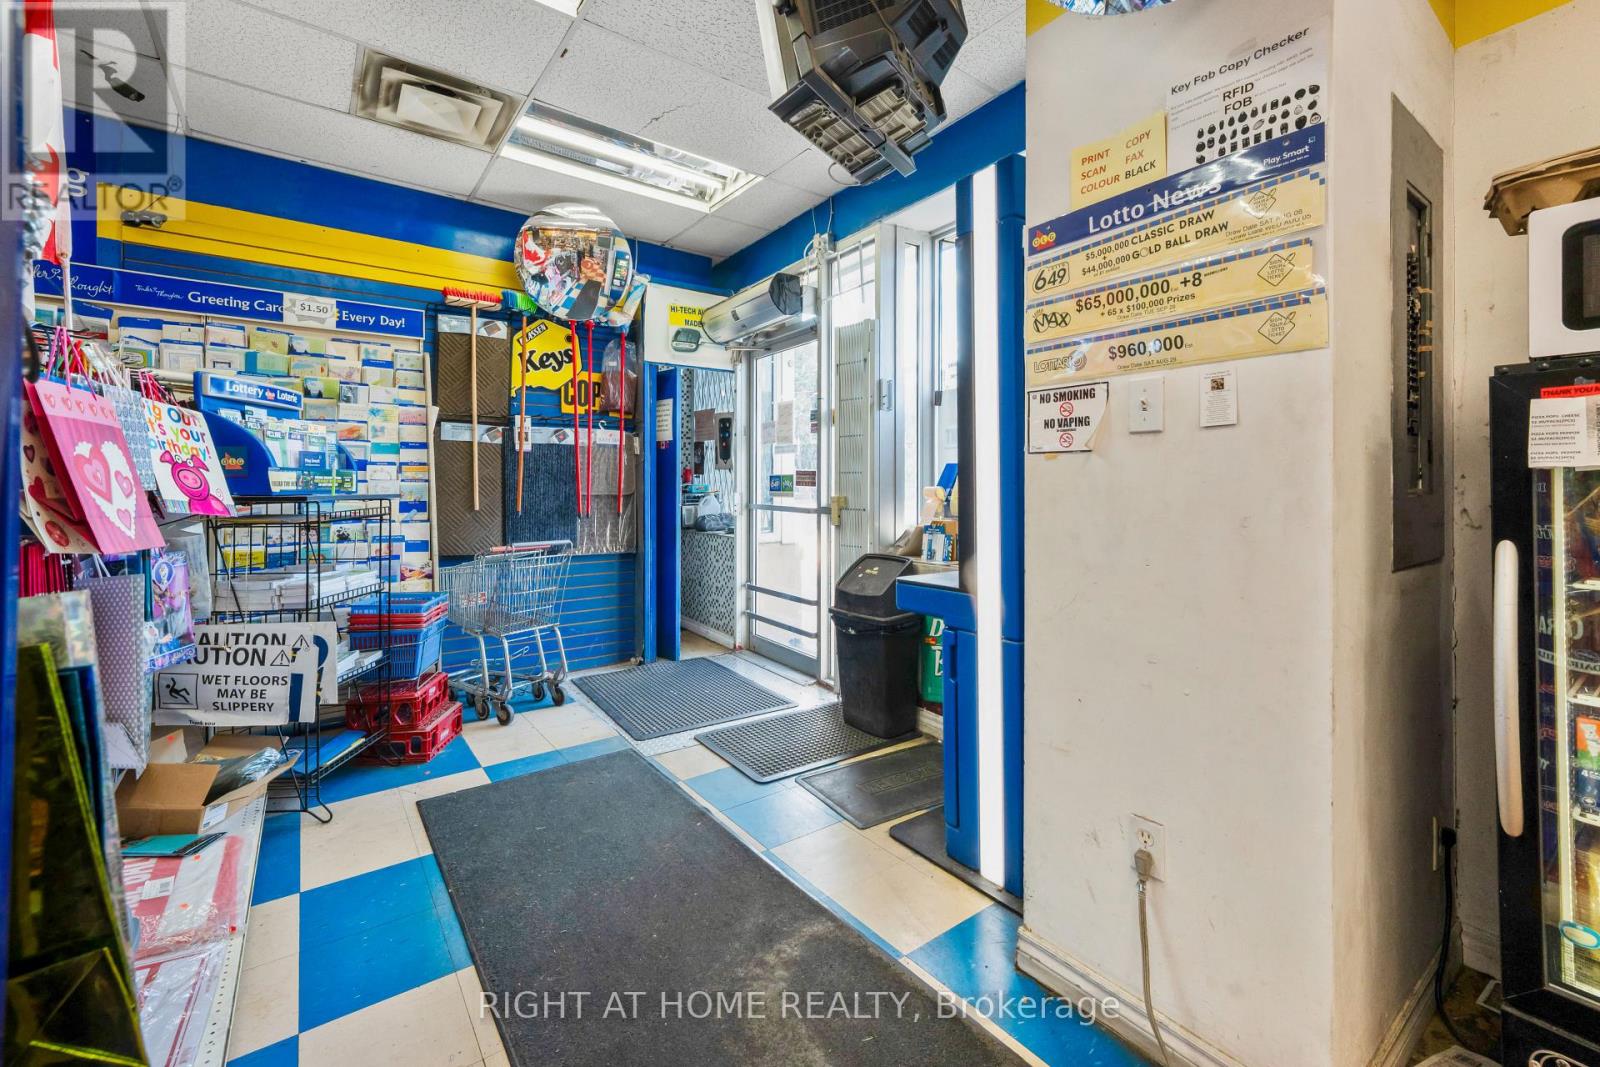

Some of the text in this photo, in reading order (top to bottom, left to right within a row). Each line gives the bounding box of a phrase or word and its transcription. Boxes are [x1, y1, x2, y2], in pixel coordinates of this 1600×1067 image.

[1171, 81, 1191, 96] Key
[1194, 70, 1215, 87] Fob
[1219, 54, 1251, 76] Copy
[1254, 27, 1310, 60] Checker
[1222, 82, 1254, 102] RFID
[1224, 96, 1253, 115] FOB
[1081, 129, 1152, 166] PRINT COPY
[1263, 153, 1281, 167] Play
[1283, 145, 1310, 160] Smart
[1081, 149, 1145, 181] SCAN FAX
[1081, 159, 1157, 195] COLOUR BLACK
[1088, 179, 1222, 236] Lotto News
[1085, 209, 1215, 262] $5,000,000 CLASSIC DRAW
[1081, 221, 1229, 277] $44,000,000 GOLD BALL DRAW
[1035, 268, 1067, 291] 649
[187, 290, 251, 312] Greeting
[1076, 279, 1170, 315] $65,000,000
[1106, 308, 1117, 318] 65
[1126, 299, 1164, 314] $100,000
[1166, 291, 1196, 306] Prizes
[299, 303, 329, 315] $1.50
[342, 310, 406, 330] Every Day!
[670, 305, 696, 316] HI-TECH
[1033, 312, 1072, 333] MAX
[1107, 334, 1185, 361] $960,000
[518, 346, 574, 374] Keys
[225, 380, 264, 398] Lottery
[277, 390, 298, 404] Loterie
[1039, 387, 1096, 405] NO SMOKING
[1044, 415, 1091, 430] NO VAPING
[195, 632, 287, 646] AUTION
[202, 674, 288, 686] WET FLOORS
[217, 688, 267, 699] MAY BE
[212, 701, 275, 713] SLIPPERY
